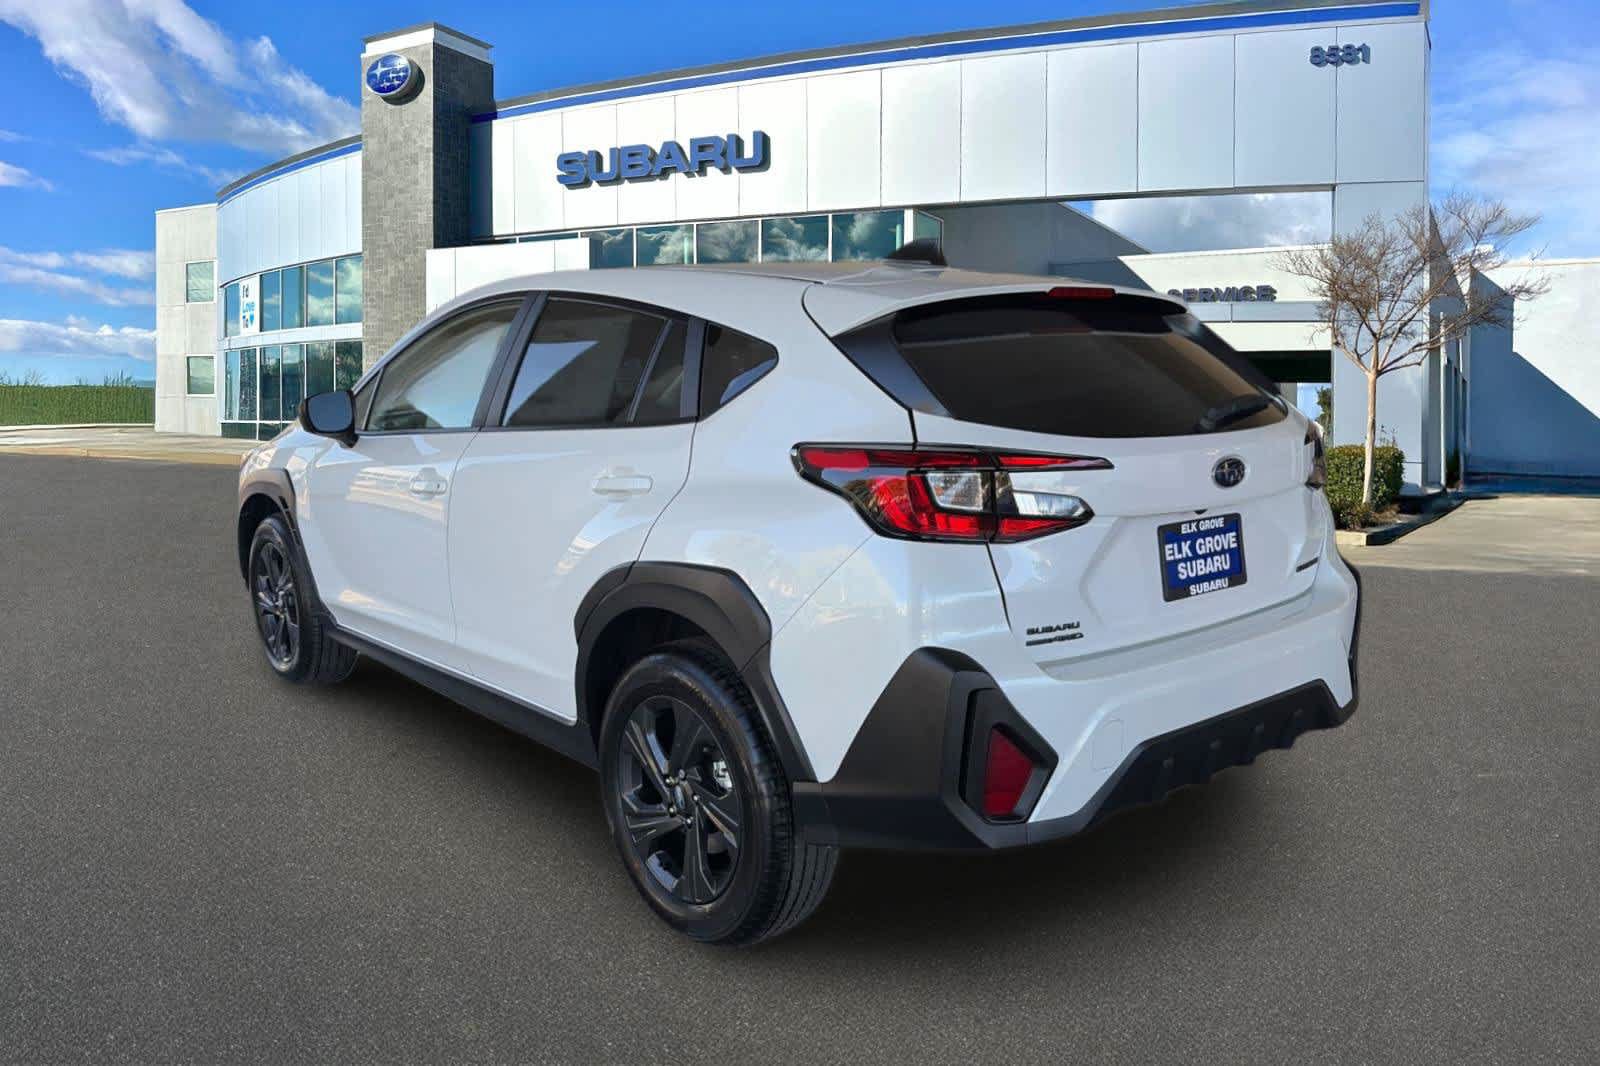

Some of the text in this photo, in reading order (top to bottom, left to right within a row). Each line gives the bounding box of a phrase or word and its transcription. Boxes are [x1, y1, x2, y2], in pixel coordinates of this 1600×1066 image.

[556, 130, 768, 188] SUBARU
[1181, 517, 1225, 534] ELK GROVE
[1165, 532, 1238, 561] ELK GROVE
[1177, 553, 1231, 579] SUBARU
[1189, 577, 1229, 595] SUBARU
